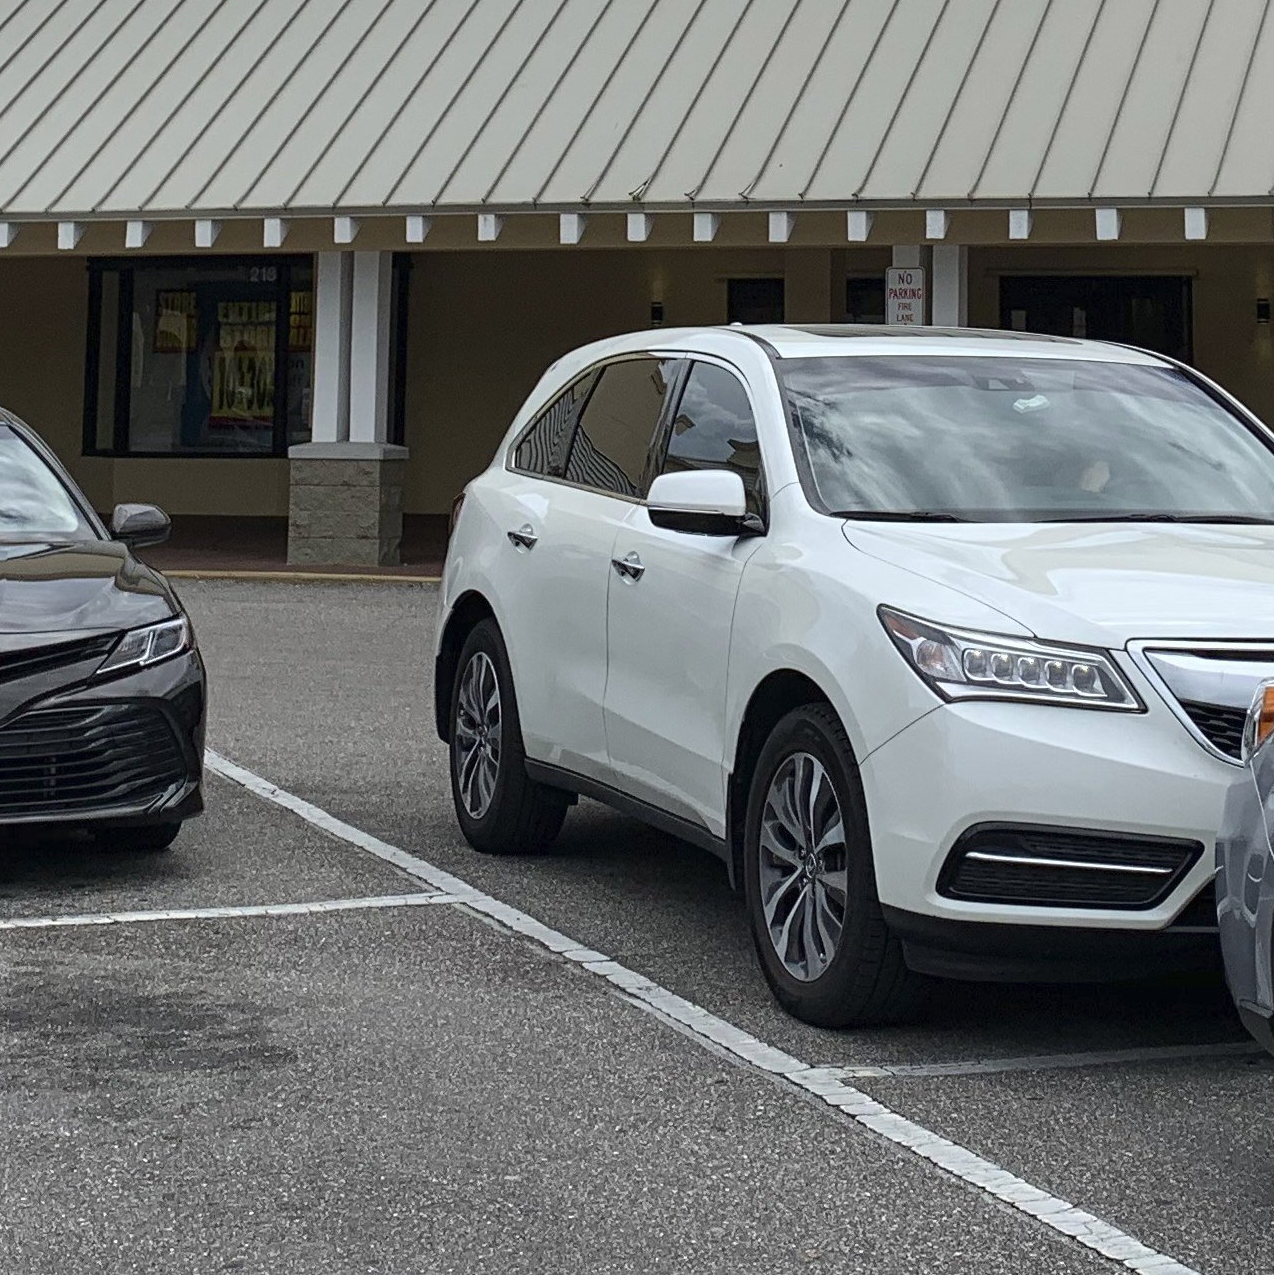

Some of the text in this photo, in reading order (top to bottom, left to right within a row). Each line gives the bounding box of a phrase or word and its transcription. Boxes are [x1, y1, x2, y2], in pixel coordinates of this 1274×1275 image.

[898, 273, 913, 285] NO
[888, 288, 923, 300] PARKING
[898, 302, 912, 311] FIRE
[896, 314, 914, 322] LANE
